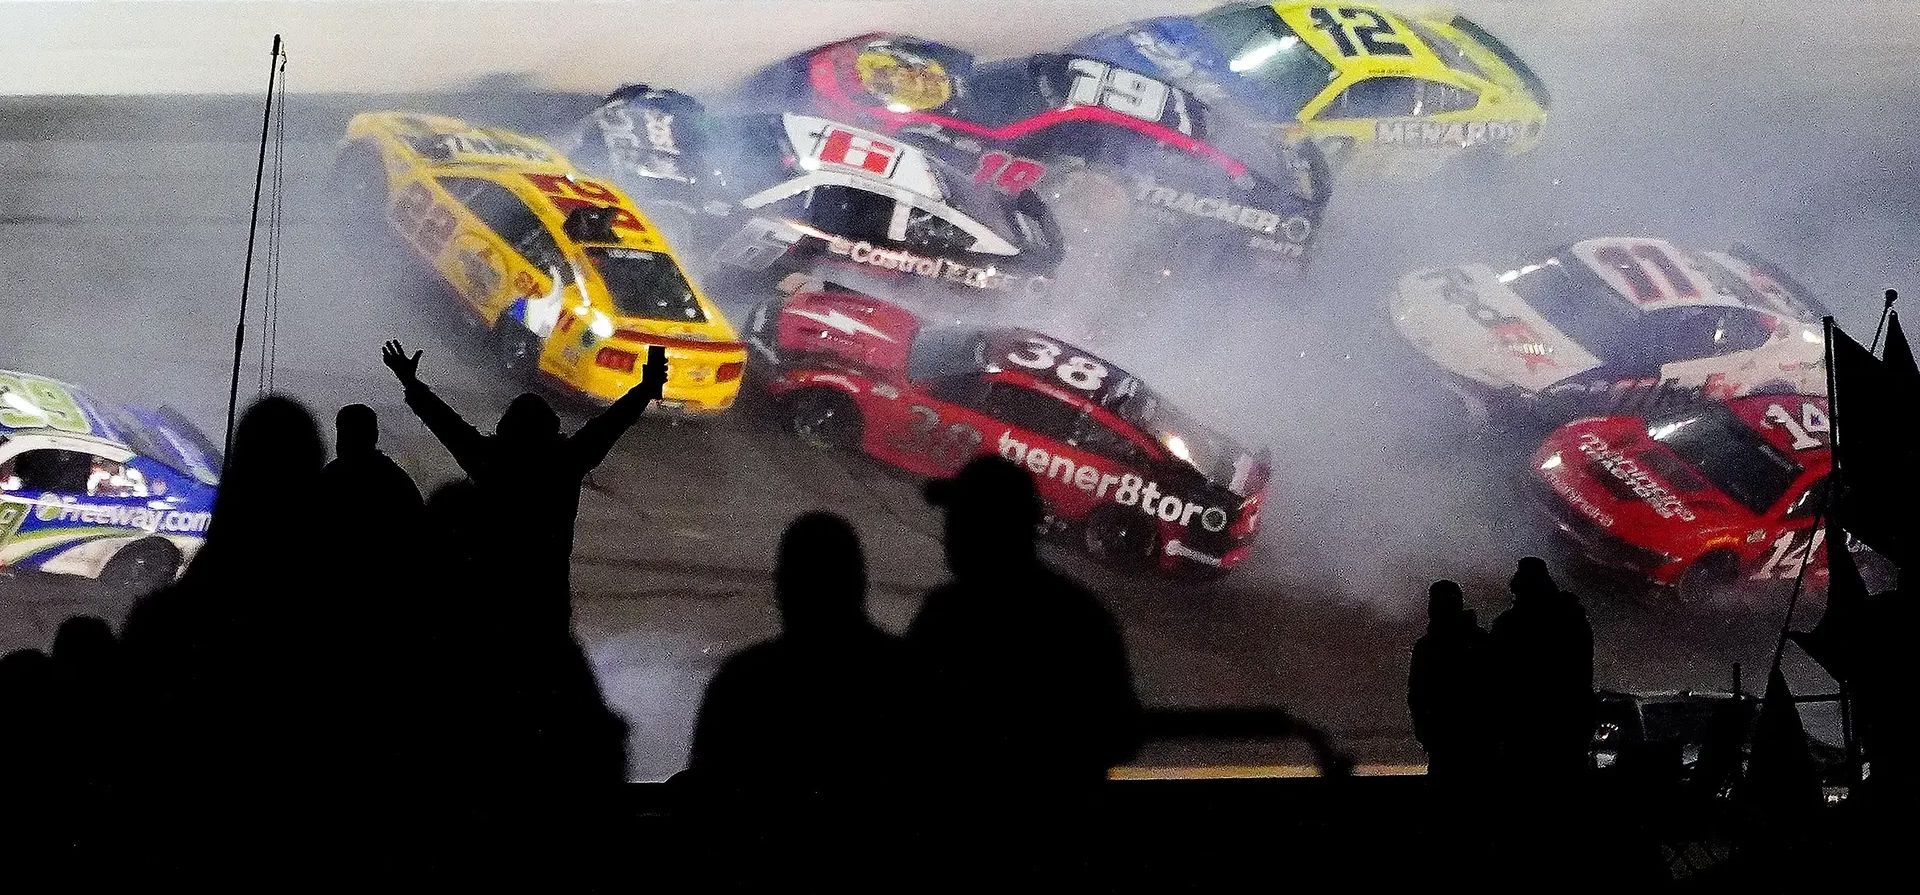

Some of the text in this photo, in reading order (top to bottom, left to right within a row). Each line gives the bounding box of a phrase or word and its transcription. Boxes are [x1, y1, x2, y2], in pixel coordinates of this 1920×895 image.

[1309, 5, 1414, 58] 12
[1068, 57, 1170, 123] 19
[850, 238, 942, 279] Castrol
[1006, 337, 1108, 392] 38
[59, 495, 212, 534] Freeway.com
[1749, 527, 1827, 580] 14
